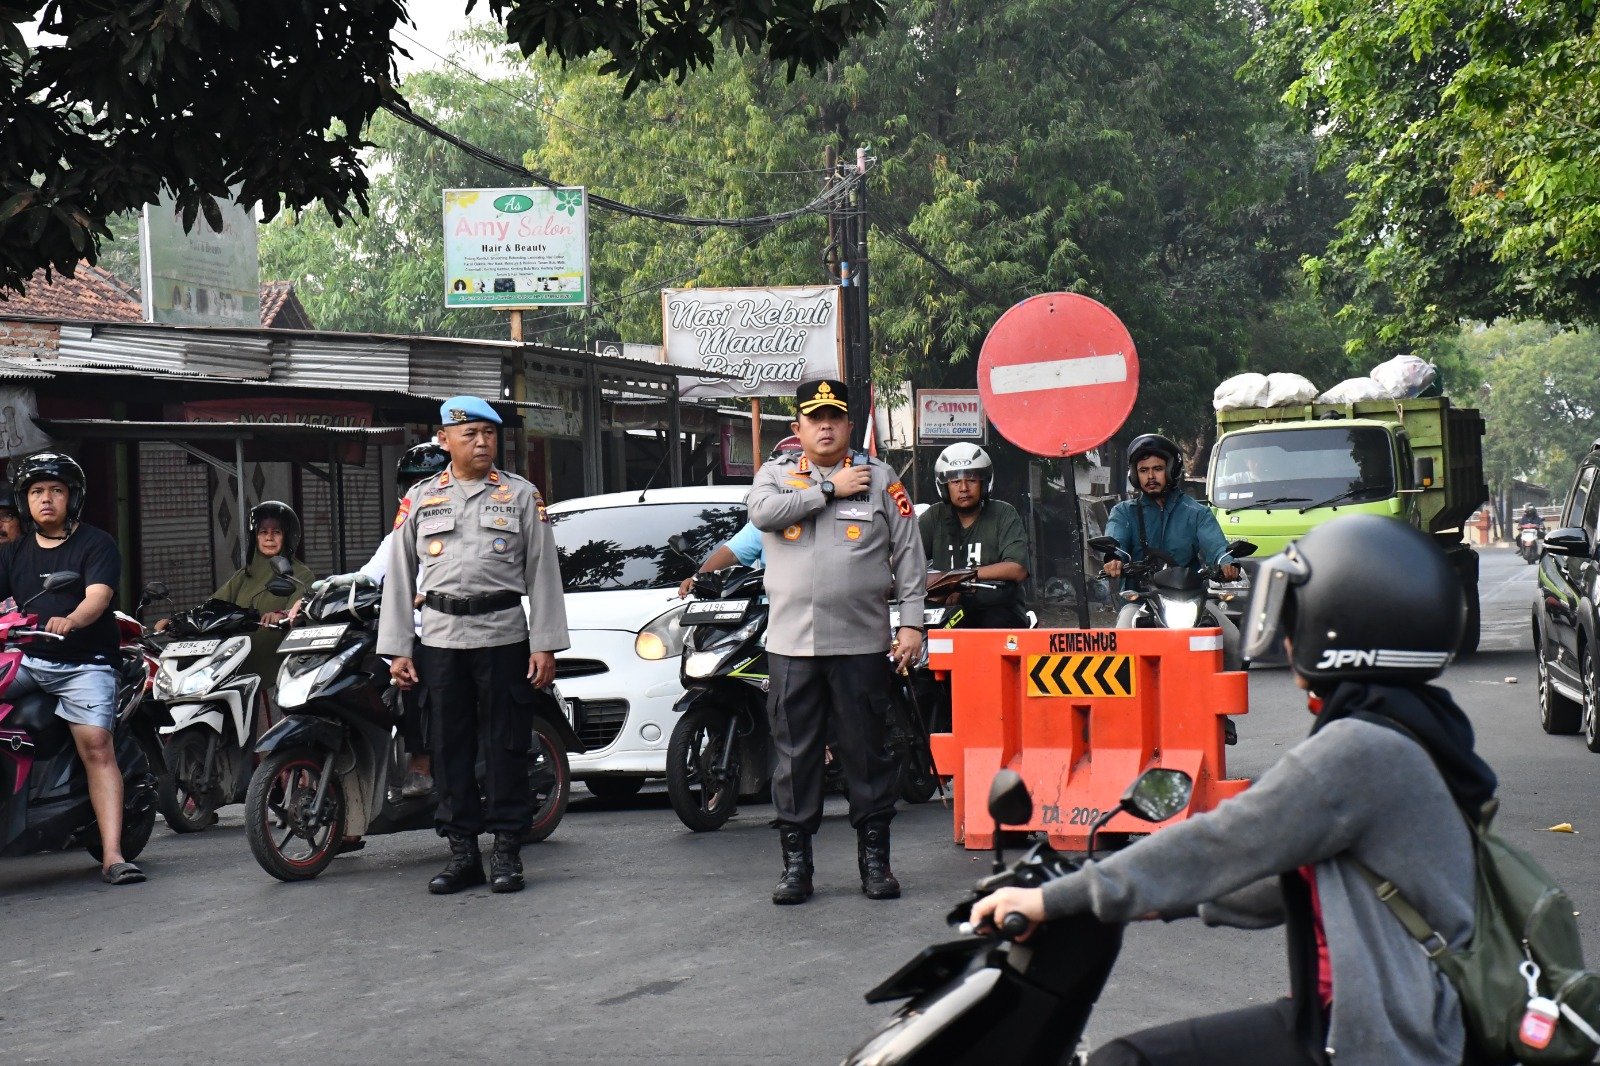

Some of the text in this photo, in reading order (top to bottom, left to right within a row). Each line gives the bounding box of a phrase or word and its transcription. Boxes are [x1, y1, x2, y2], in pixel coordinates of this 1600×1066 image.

[505, 196, 522, 212] As
[455, 215, 573, 240] Amy Salon
[481, 243, 547, 254] Hair & Beauty
[669, 298, 833, 329] Nasi Kebuli
[695, 326, 807, 355] Mandhi
[699, 354, 807, 389] Briyani
[924, 400, 978, 413] Canon
[422, 507, 453, 518] WARDOYO
[485, 505, 516, 514] POLRI
[1049, 631, 1117, 653] KEMENHUB
[733, 656, 752, 670] HONDA
[1316, 649, 1376, 669] JPN
[1069, 806, 1105, 826] 202
